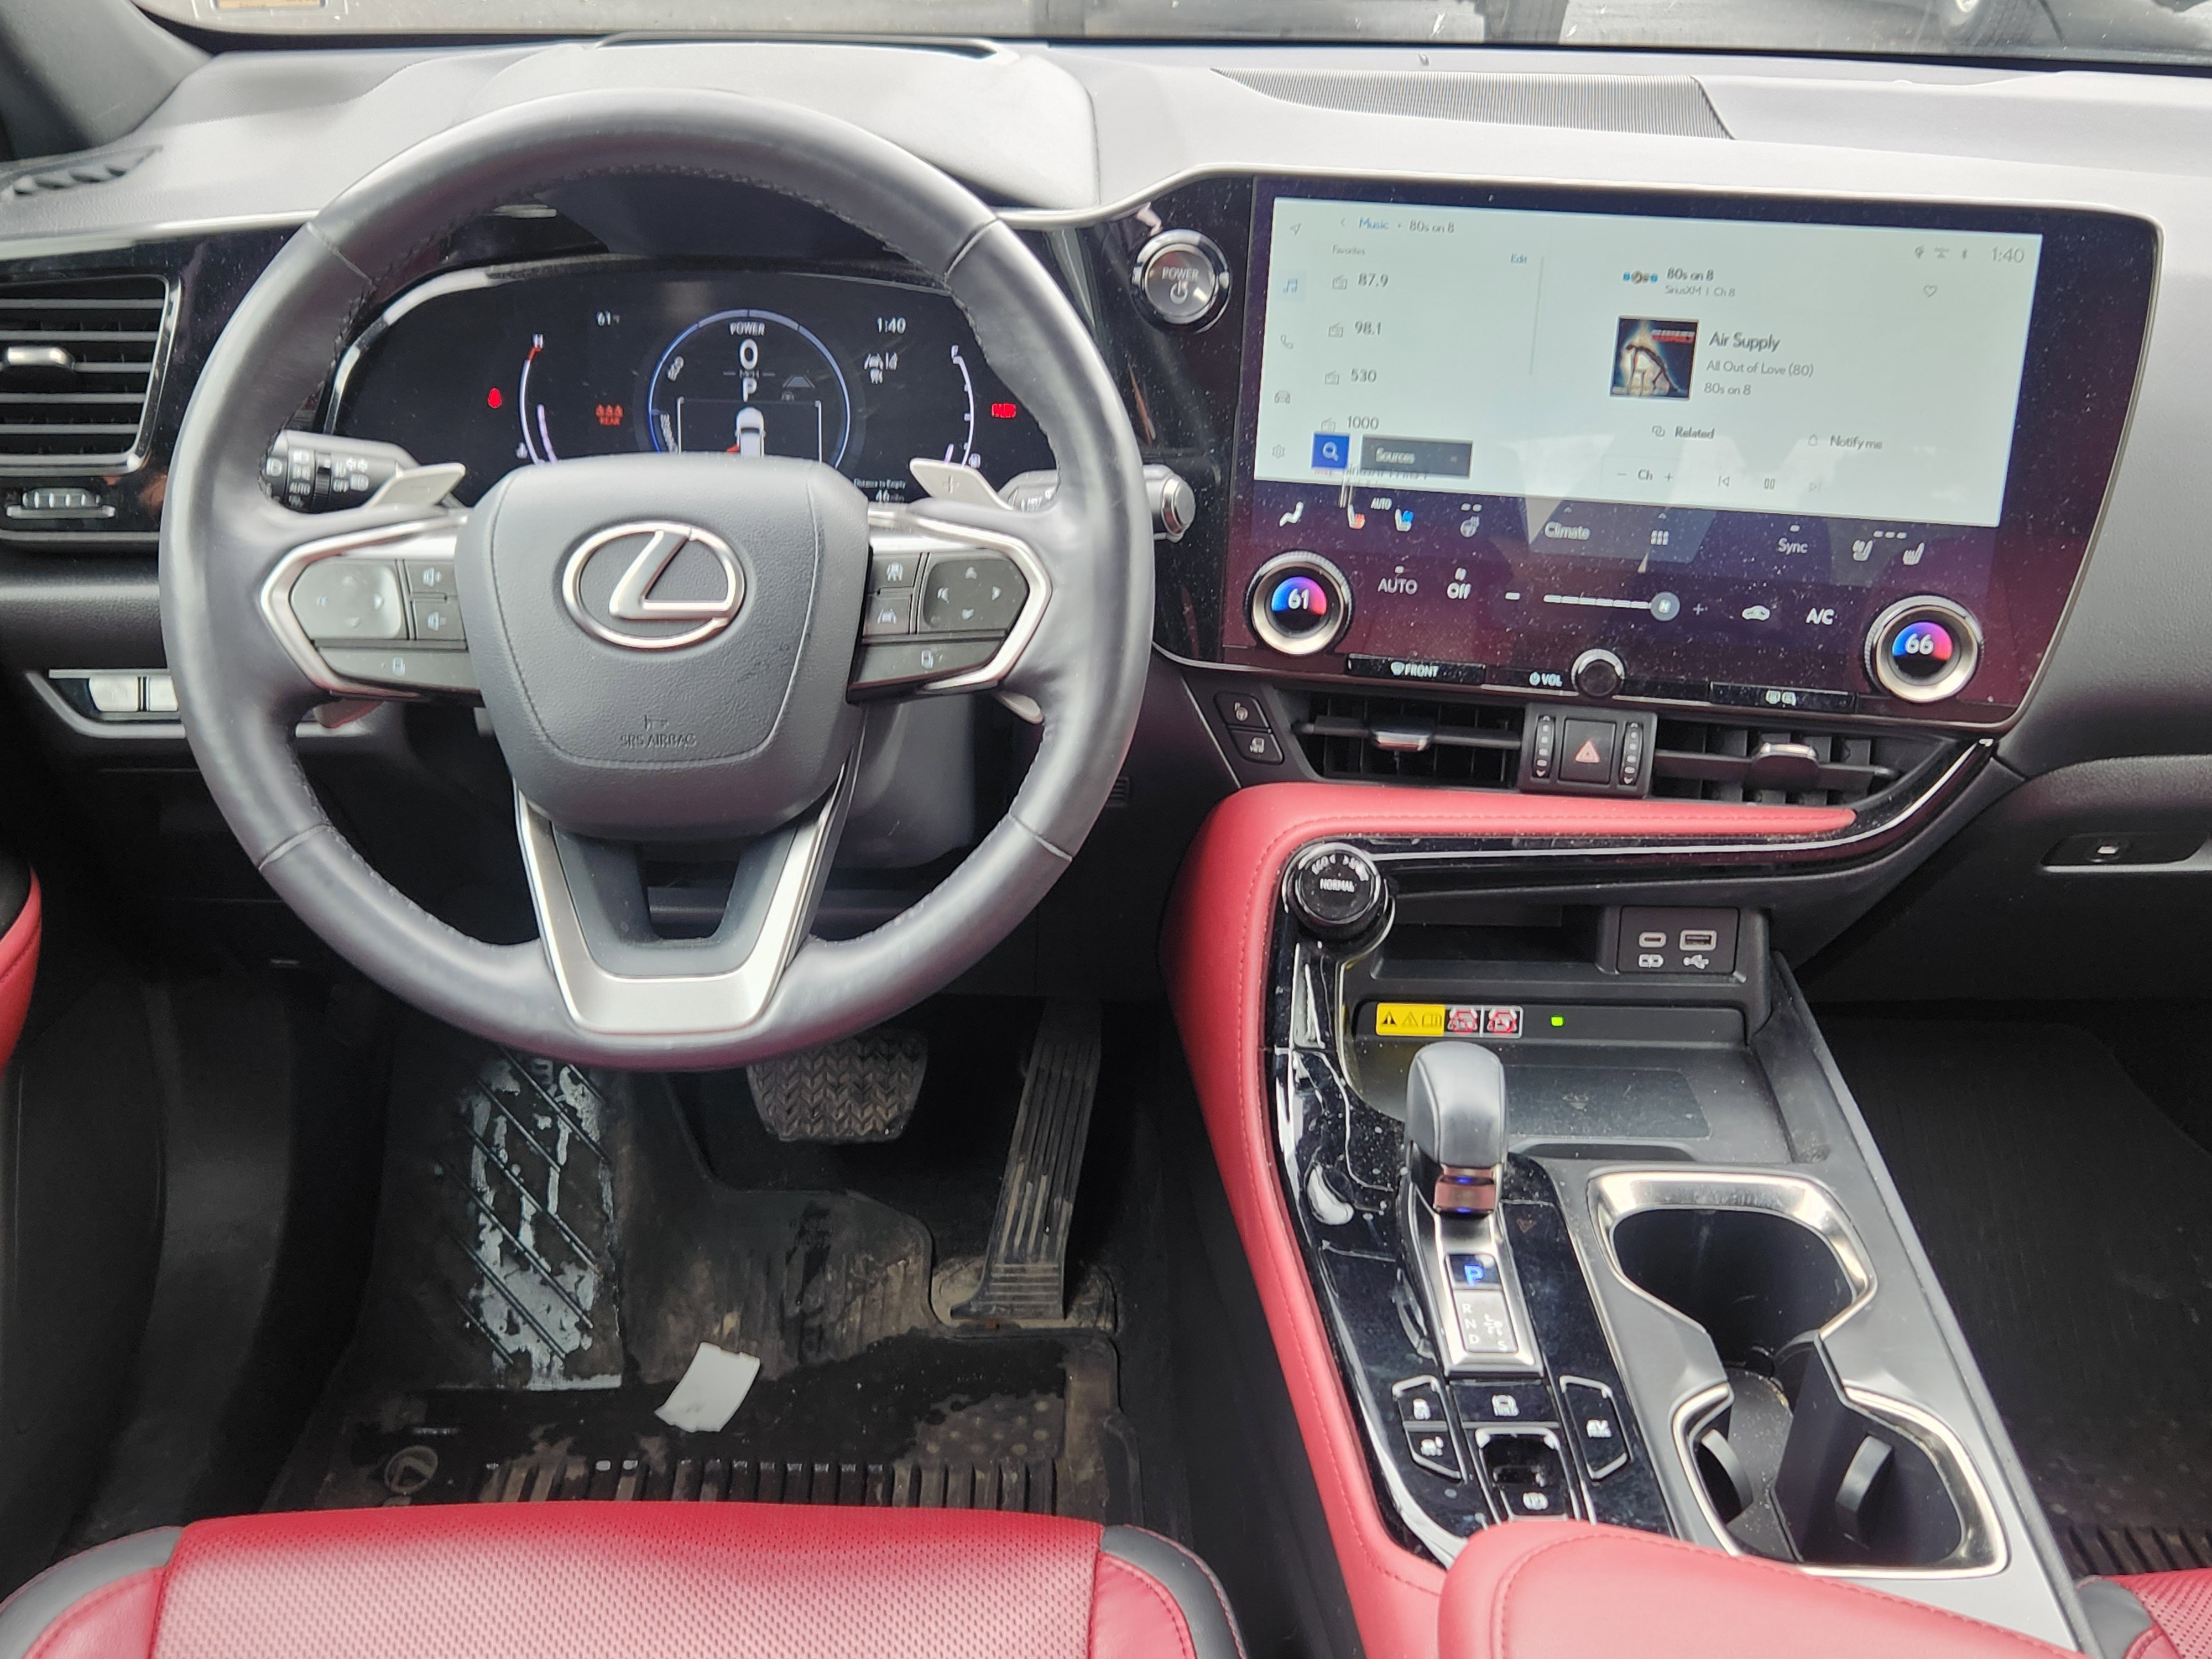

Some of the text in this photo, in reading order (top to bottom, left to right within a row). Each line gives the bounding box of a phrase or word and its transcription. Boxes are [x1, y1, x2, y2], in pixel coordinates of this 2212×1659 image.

[1359, 217, 1389, 230] Music
[1332, 245, 1365, 255] Favorites
[1992, 246, 2025, 263] 1:40
[1510, 253, 1528, 265] Edit
[1162, 267, 1199, 281] POWER
[1358, 273, 1389, 288] 87.9
[1667, 267, 1687, 280] 80s
[1690, 271, 1704, 281] on
[1665, 285, 1736, 298] SiriusXM Ch 8
[729, 321, 765, 336] POWER
[877, 317, 906, 334] 1:40
[1354, 321, 1383, 336] 98.1
[1709, 331, 1729, 346] Air
[1733, 332, 1780, 352] Supply
[1350, 369, 1378, 383] 530
[1706, 360, 1814, 378] All Out of Love (80)
[743, 377, 758, 403] P
[1704, 382, 1752, 396] 80s on 8
[1347, 415, 1380, 430] 1000
[1674, 426, 1715, 439] Related
[1829, 435, 1882, 450] Notify me
[1637, 469, 1653, 482] Ch
[1371, 498, 1392, 510] AUTO
[1545, 522, 1591, 541] Climate
[1778, 538, 1808, 555] Sync
[1378, 578, 1418, 595] AUTO
[1288, 588, 1310, 609] 61
[1806, 608, 1834, 625] A/C
[1905, 633, 1934, 655] 66
[1405, 663, 1439, 678] FRONT
[1541, 674, 1563, 687] VOL
[646, 733, 697, 750] AIRBAG
[1320, 878, 1355, 893] NORMAL
[1464, 1264, 1484, 1287] P
[1462, 1303, 1472, 1314] R
[1464, 1318, 1477, 1329] N
[1468, 1333, 1480, 1344] D
[1498, 1340, 1508, 1352] S
